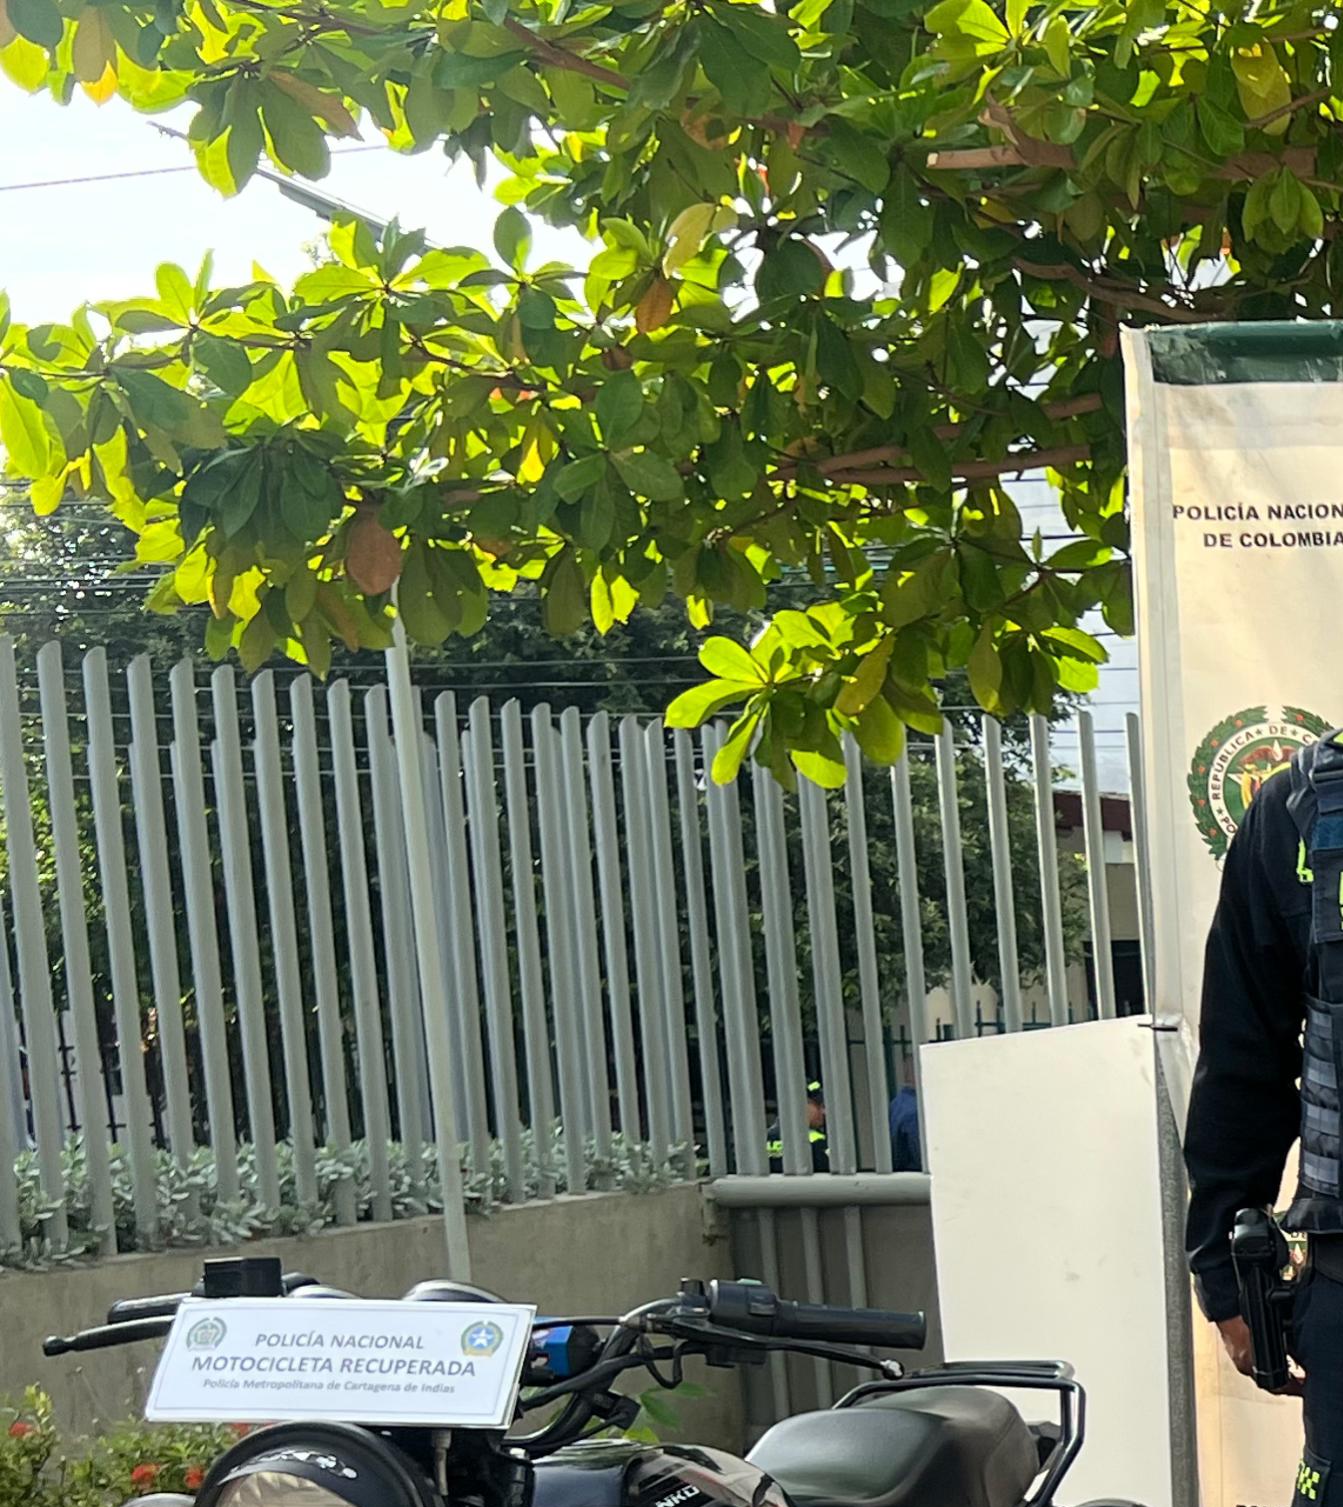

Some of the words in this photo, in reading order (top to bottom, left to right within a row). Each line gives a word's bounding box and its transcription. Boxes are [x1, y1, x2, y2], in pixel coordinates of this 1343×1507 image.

[1172, 502, 1260, 521] POLICÍA
[1203, 532, 1233, 548] DE
[1268, 725, 1289, 735] DE
[255, 1330, 325, 1349] POLICÍA
[331, 1334, 425, 1351] NACIONAL
[191, 1355, 333, 1375] MOTOCICLETA
[340, 1357, 476, 1377] RECUPERADA
[203, 1378, 240, 1390] Policía
[243, 1379, 324, 1393] Metropolitana
[327, 1380, 341, 1391] de
[344, 1381, 402, 1395] Cartagena
[405, 1382, 419, 1393] de
[421, 1383, 456, 1394] Indias
